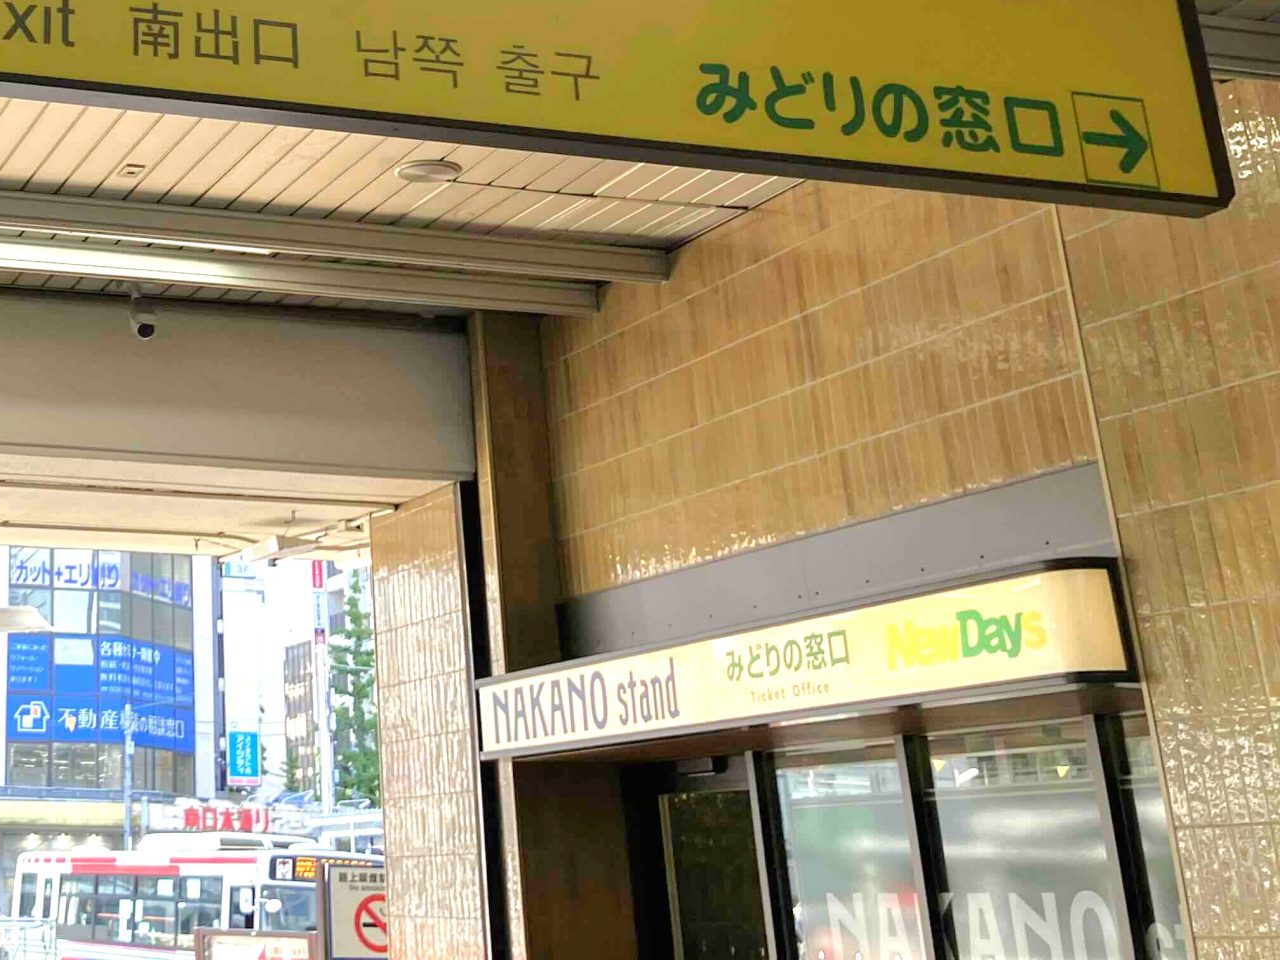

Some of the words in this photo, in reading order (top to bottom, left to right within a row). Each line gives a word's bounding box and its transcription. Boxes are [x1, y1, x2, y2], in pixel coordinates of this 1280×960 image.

[130, 2, 300, 69] 南出口
[355, 30, 466, 89] 남쪽
[496, 44, 602, 101] 출구
[696, 63, 1065, 158] みどりの窓口
[726, 629, 850, 682] みどりの窓口
[492, 670, 608, 745] NAKANO
[616, 659, 680, 726] stand
[750, 684, 786, 704] Ticket
[793, 680, 830, 697] Office
